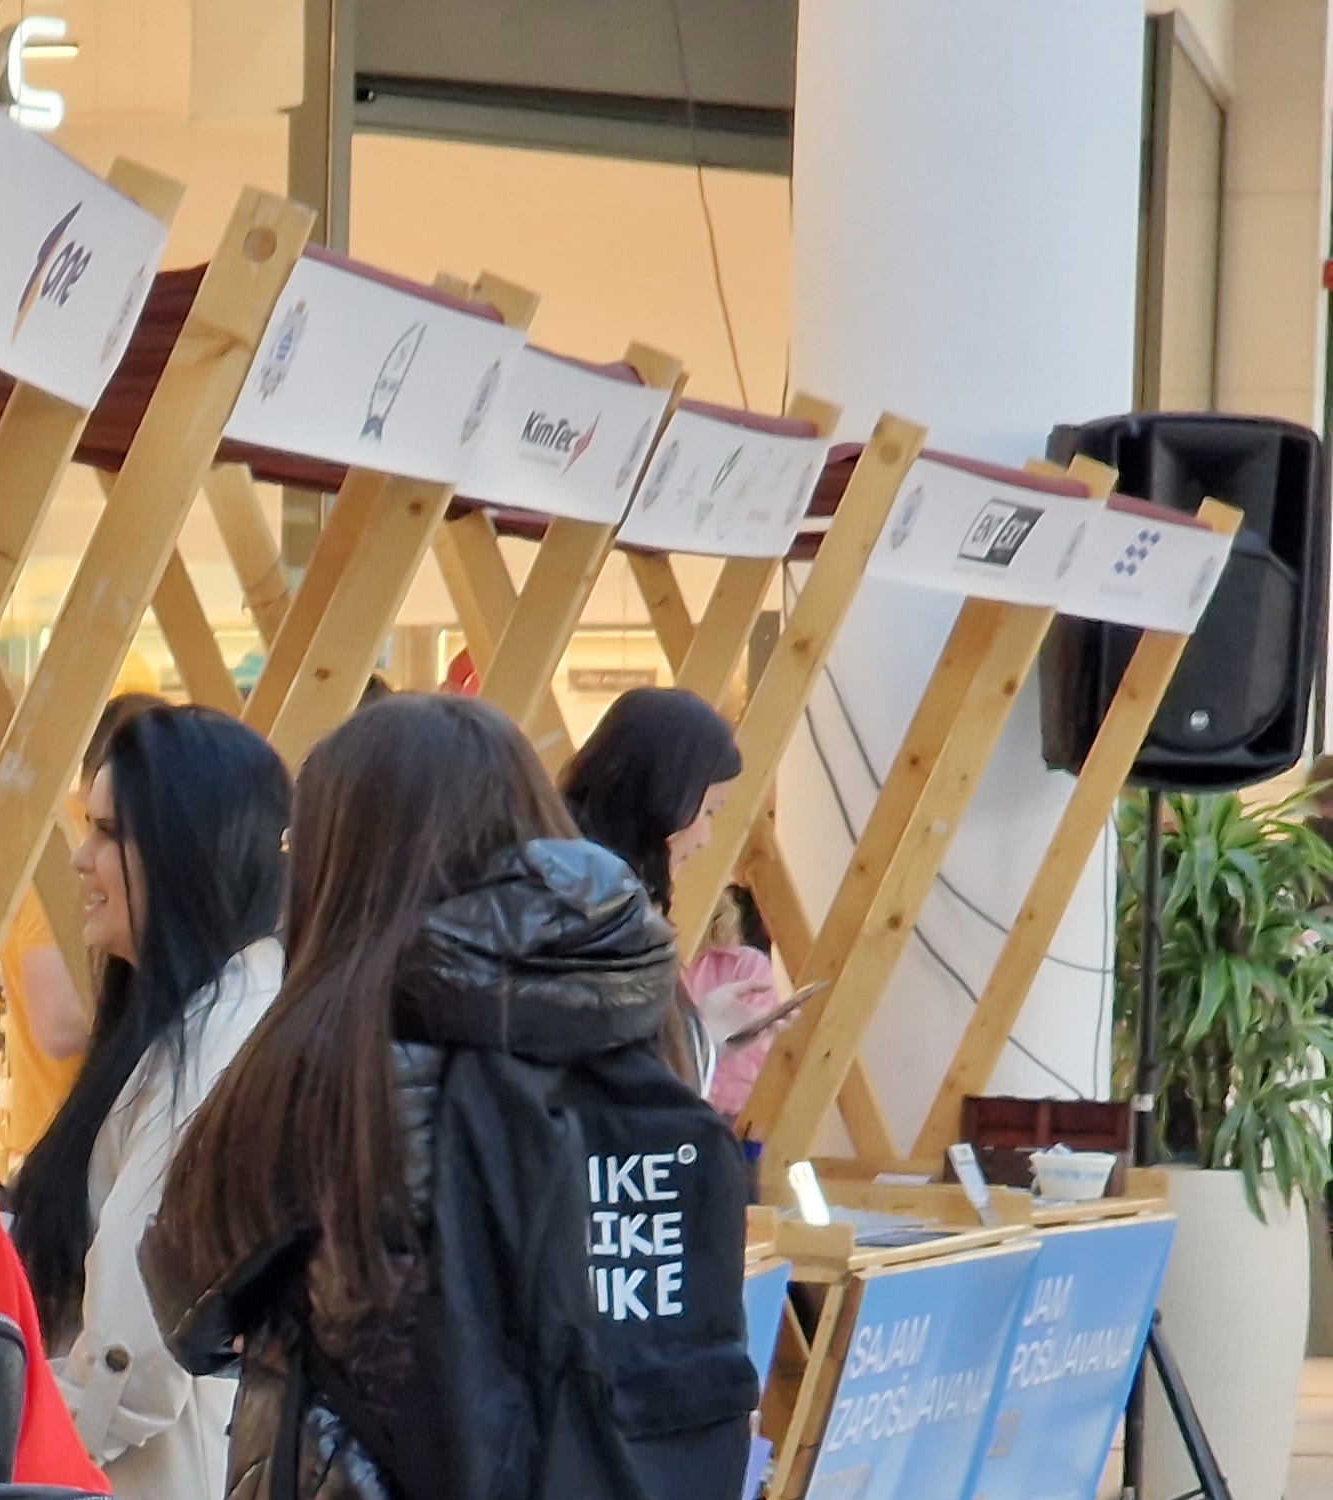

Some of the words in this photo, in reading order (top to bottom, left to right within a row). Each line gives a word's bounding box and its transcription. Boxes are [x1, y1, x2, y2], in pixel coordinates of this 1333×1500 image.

[521, 410, 580, 452] KimTec
[587, 1154, 681, 1205] IKE
[586, 1211, 684, 1259] IKE
[588, 1262, 683, 1321] IKE
[1023, 1274, 1074, 1328] JAM
[850, 1316, 931, 1379] SAJAM
